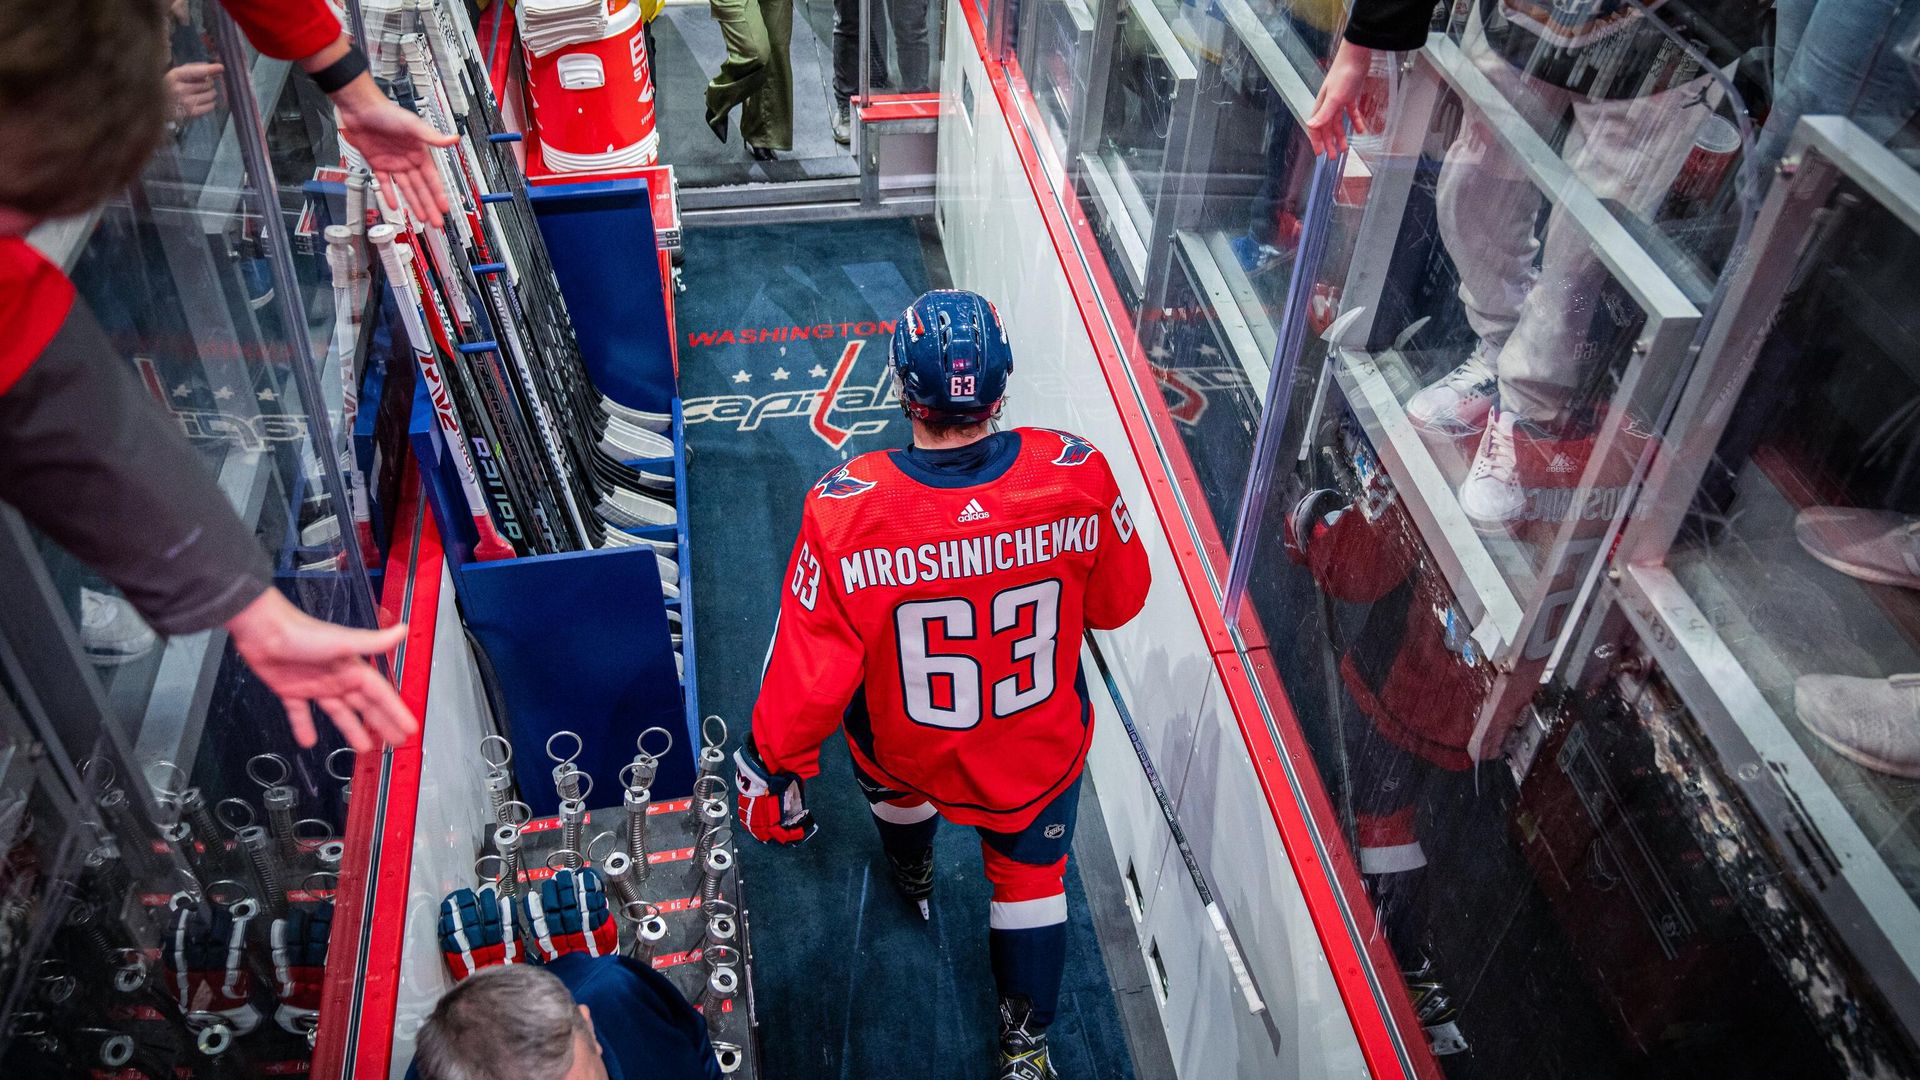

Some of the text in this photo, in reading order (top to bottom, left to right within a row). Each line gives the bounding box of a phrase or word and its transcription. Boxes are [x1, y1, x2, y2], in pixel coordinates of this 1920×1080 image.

[687, 319, 898, 348] WASHINGTON
[950, 375, 976, 397] 63
[957, 508, 991, 524] adidas
[791, 541, 822, 612] 63
[839, 513, 1100, 595] MIROSHNICHENKO
[893, 577, 1063, 731] 63
